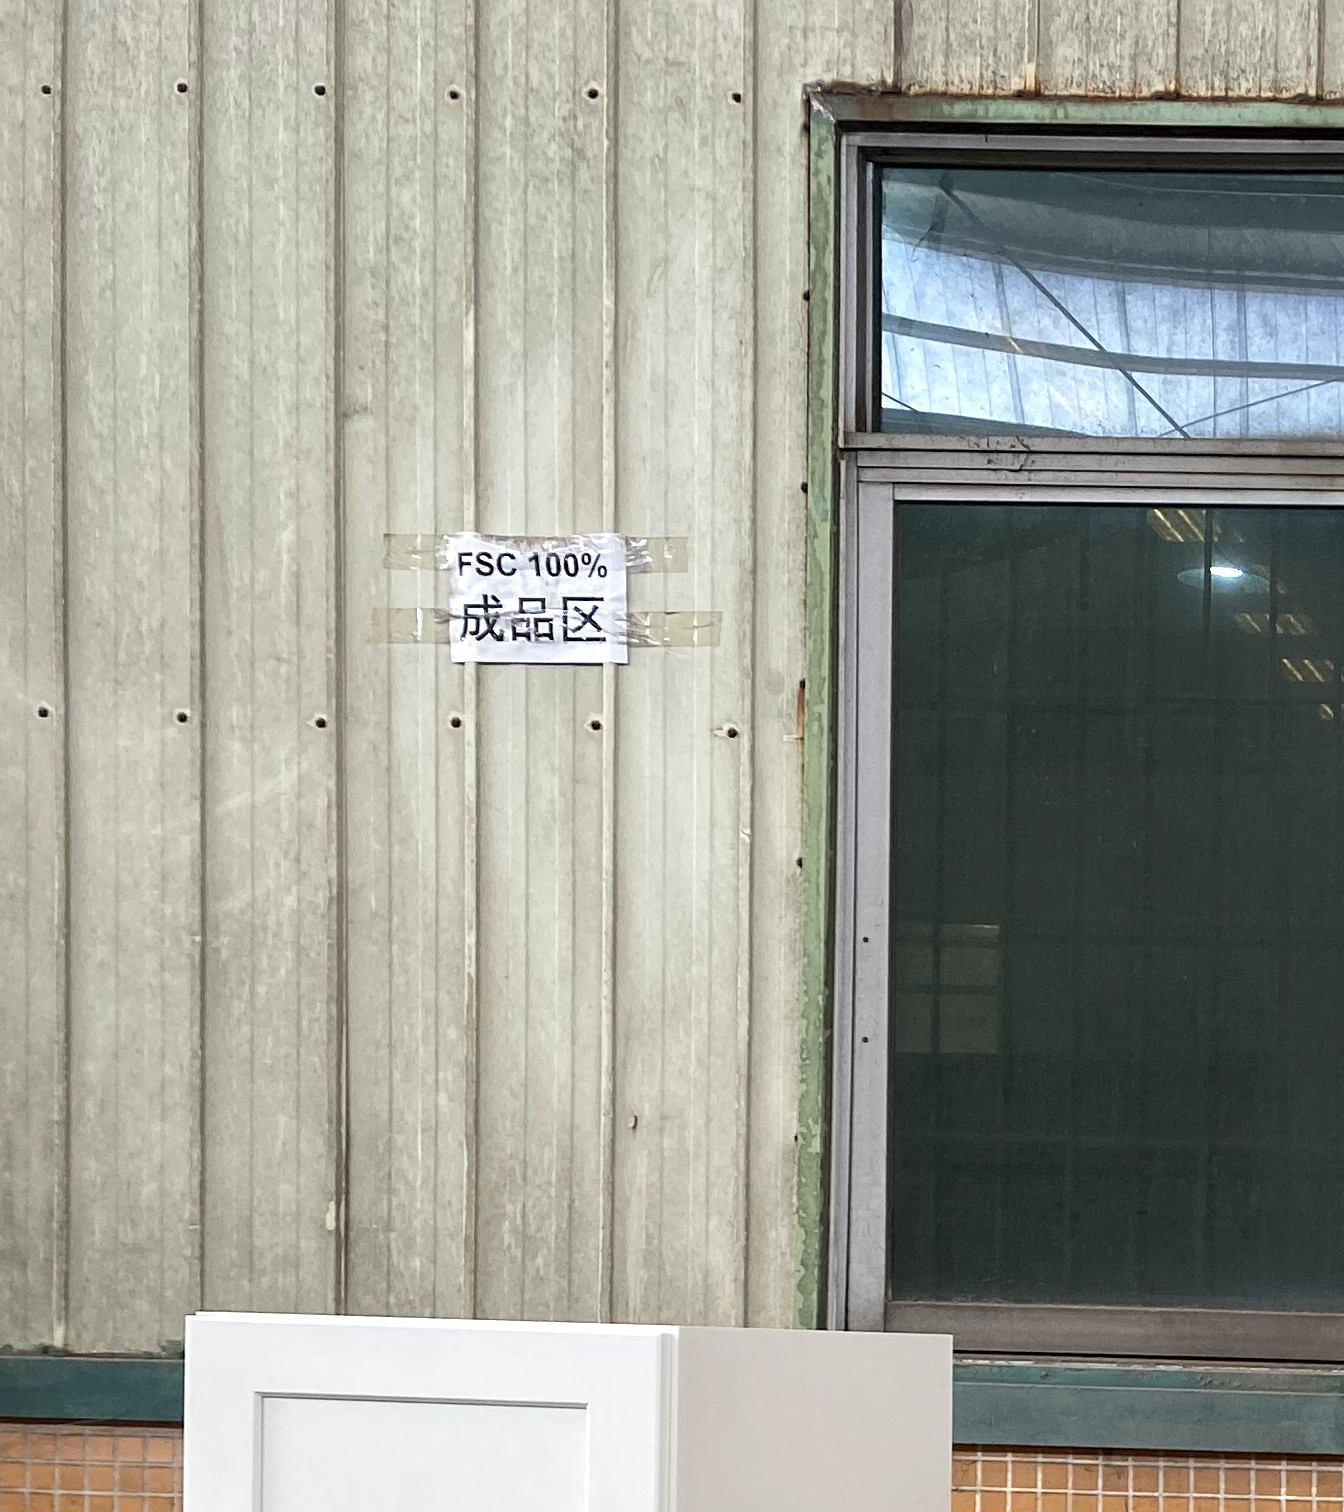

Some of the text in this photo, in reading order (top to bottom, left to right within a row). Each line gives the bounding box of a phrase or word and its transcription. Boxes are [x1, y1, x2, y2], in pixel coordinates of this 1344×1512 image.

[458, 552, 608, 578] FSC 100%
[460, 594, 607, 642] 成品区
